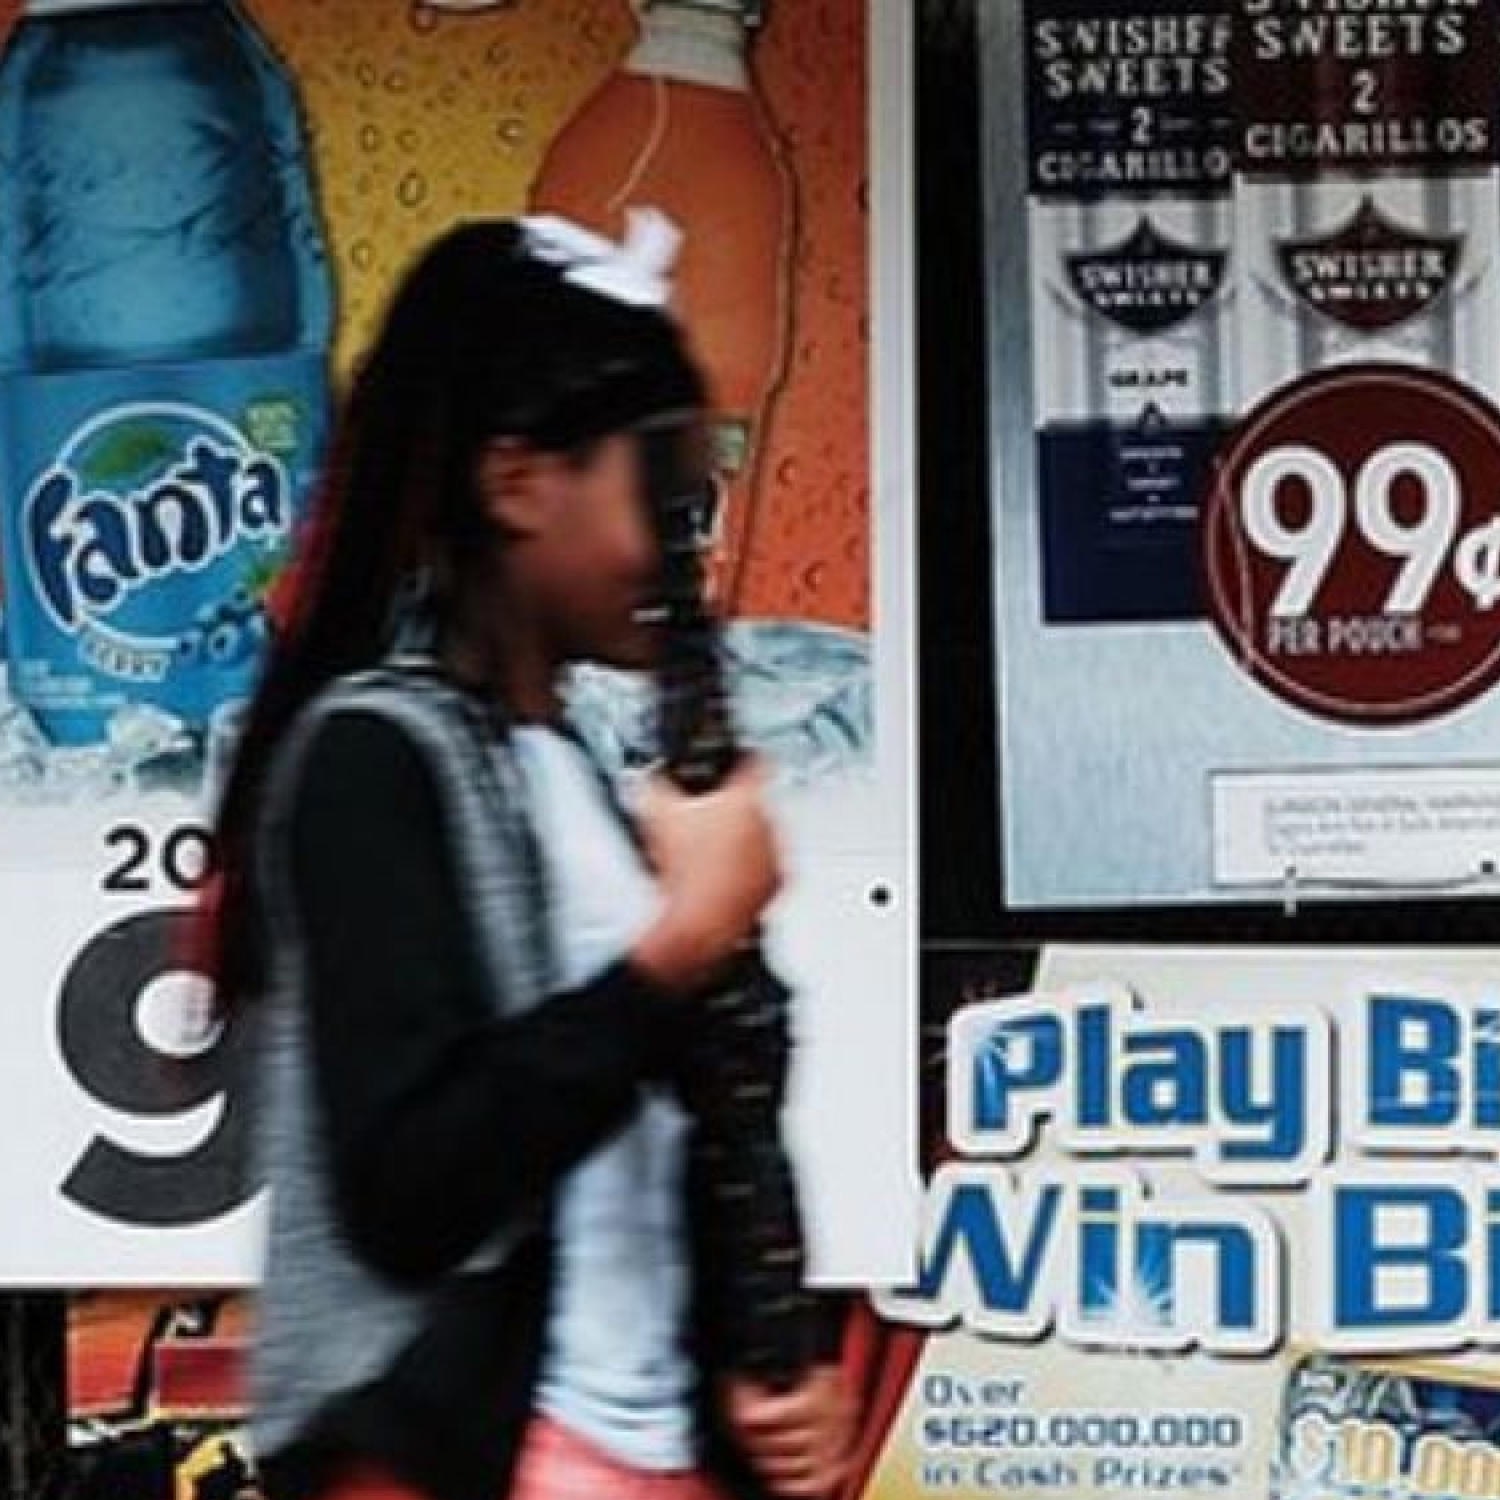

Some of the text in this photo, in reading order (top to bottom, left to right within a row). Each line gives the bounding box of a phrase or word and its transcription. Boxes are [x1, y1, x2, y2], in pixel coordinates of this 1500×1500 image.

[1252, 14, 1468, 60] SWEETS
[1353, 69, 1379, 115] 2
[1130, 106, 1154, 145] 2
[1244, 118, 1491, 159] CIGARILLOS
[26, 435, 285, 628] Fanta
[1268, 616, 1321, 655] PER
[1328, 614, 1424, 654] POUCH
[970, 996, 1308, 1163] Play
[923, 1375, 1022, 1406] Over
[923, 1462, 959, 1486] in
[974, 1456, 1078, 1486] Cash
